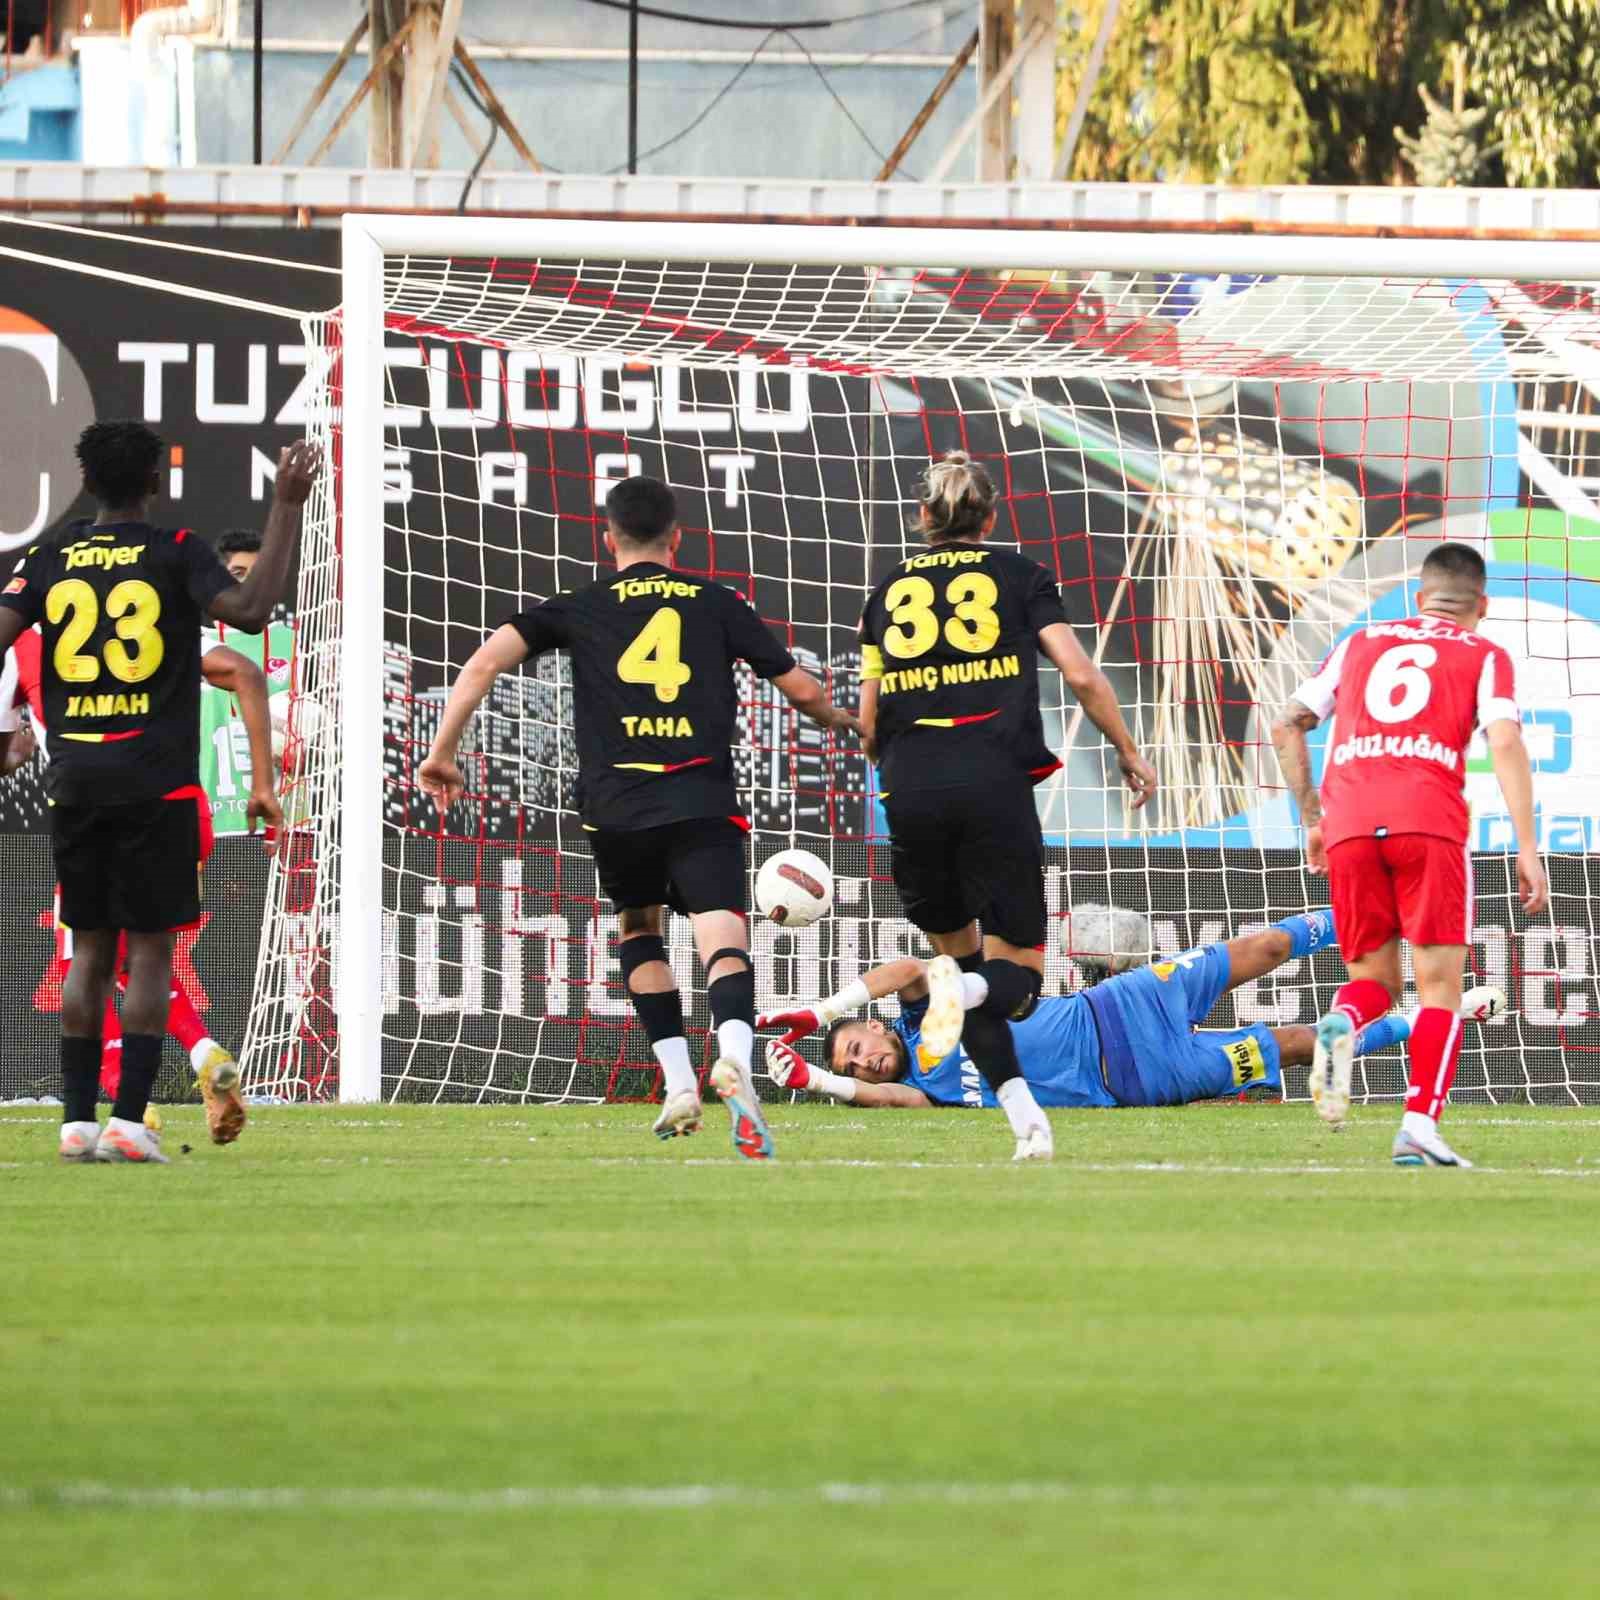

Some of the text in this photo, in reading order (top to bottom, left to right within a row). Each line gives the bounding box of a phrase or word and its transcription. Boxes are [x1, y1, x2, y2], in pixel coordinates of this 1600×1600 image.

[60, 541, 146, 571] Tanyer
[900, 550, 990, 572] Tanyer
[608, 576, 702, 602] Tanyer
[883, 571, 1001, 659] 33
[45, 578, 164, 683] 23
[616, 606, 692, 703] 4
[942, 655, 1020, 685] NUKAN
[1364, 642, 1438, 724] 6
[621, 715, 694, 738] TAHA
